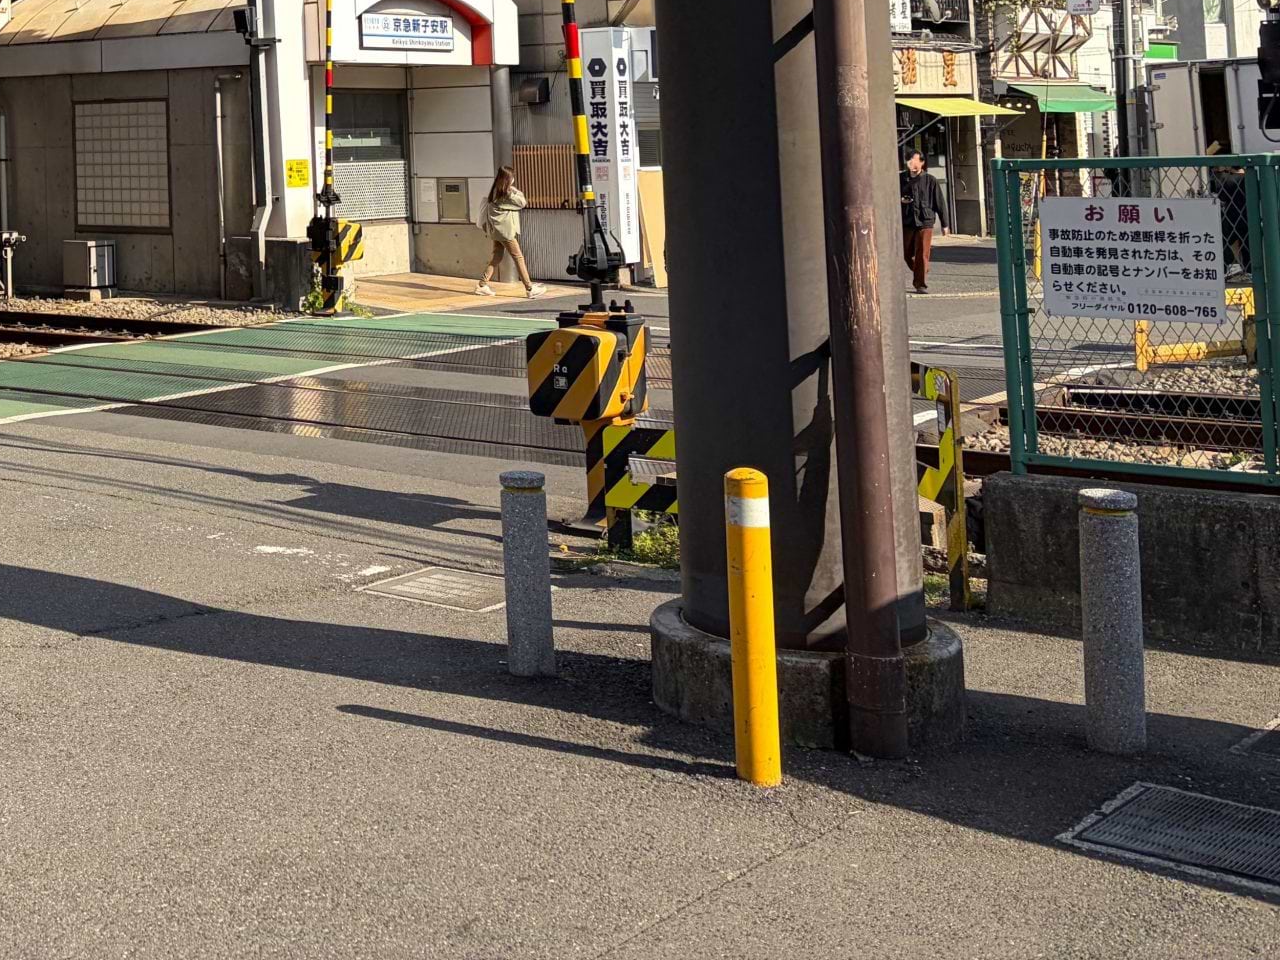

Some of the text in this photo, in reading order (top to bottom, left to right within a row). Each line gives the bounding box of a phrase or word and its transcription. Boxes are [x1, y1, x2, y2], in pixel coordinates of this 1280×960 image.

[393, 18, 448, 34] 京急新子安駅
[589, 80, 609, 157] 買取大吉
[618, 80, 630, 156] 買取大吉
[1084, 204, 1174, 224] お願い
[1048, 228, 1216, 244] 事故防止のため遮断桿を折った
[1049, 245, 1217, 263] 自動車を発見された方は、その
[1050, 263, 1218, 281] 自動車の記号とナンバーをお知
[1052, 280, 1127, 296] らせください。
[1071, 302, 1218, 318] フリーダイヤル 0120-608-765
